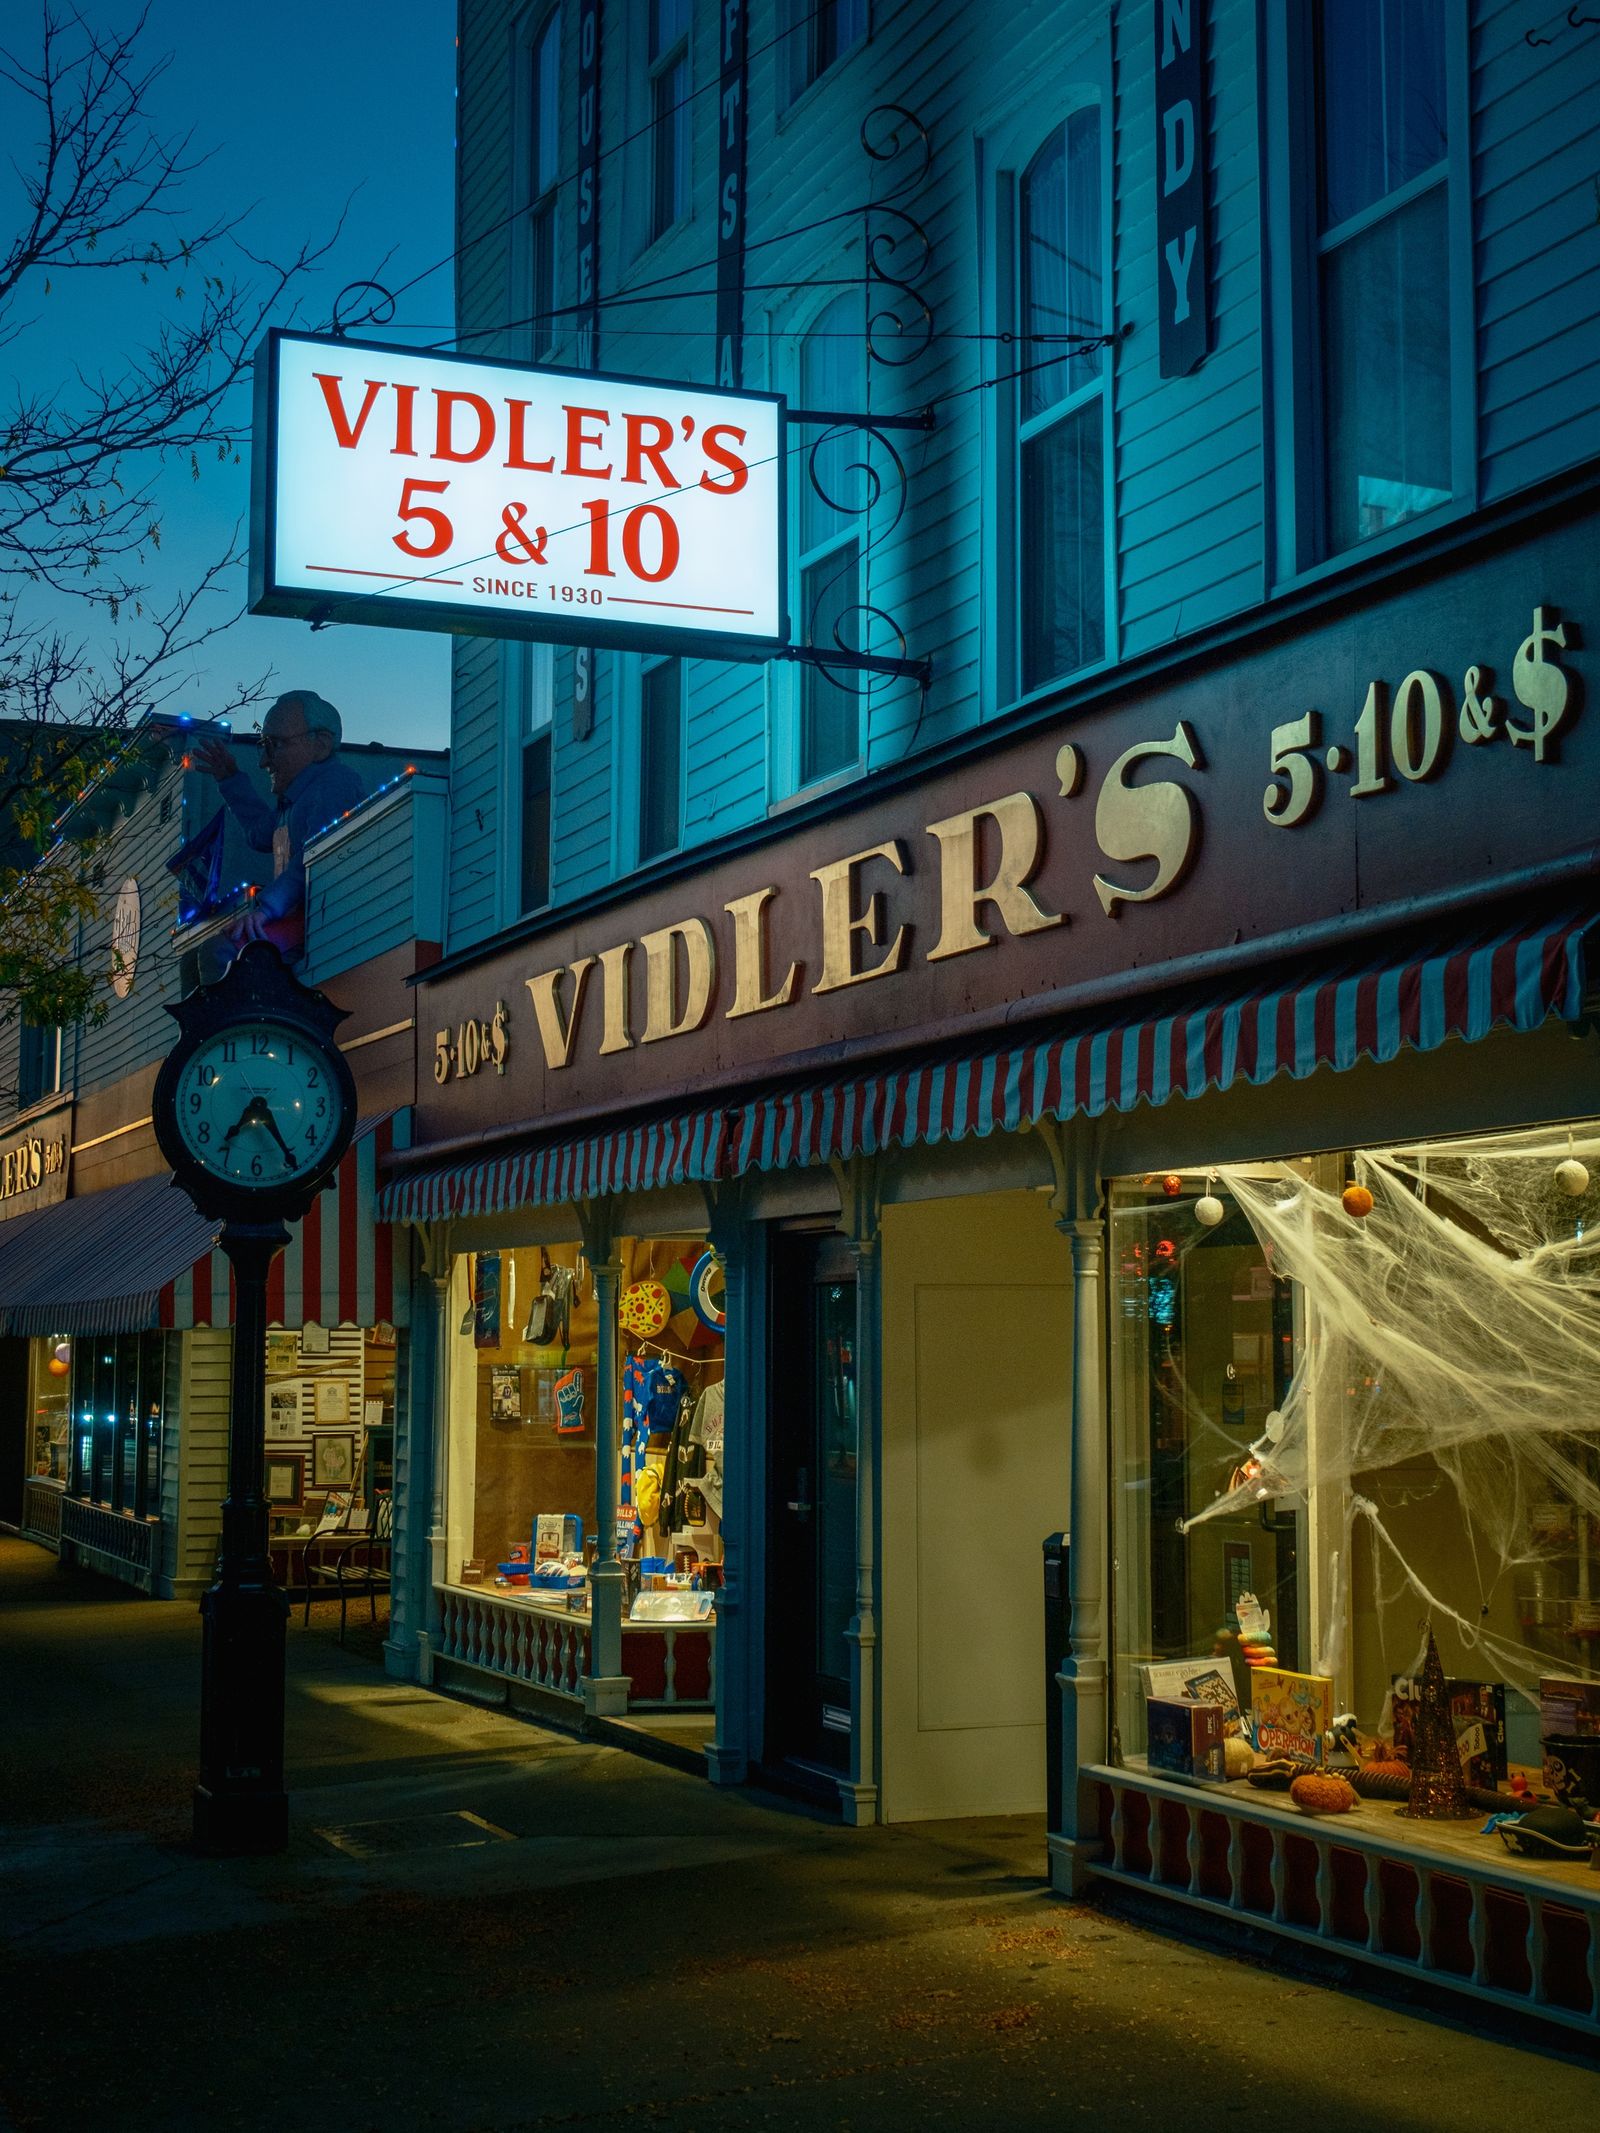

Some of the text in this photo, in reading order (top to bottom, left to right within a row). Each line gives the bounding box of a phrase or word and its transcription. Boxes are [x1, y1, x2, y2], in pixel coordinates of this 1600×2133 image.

[312, 372, 749, 495] VIDLER'S
[391, 477, 680, 583] 5 & 10
[472, 576, 603, 606] SINCE 1930
[525, 720, 1206, 1070] VIDLER'S
[222, 1041, 237, 1063] 11
[252, 1033, 270, 1056] 12
[287, 1043, 295, 1066] 1
[196, 1064, 216, 1087] 10
[306, 1066, 319, 1089] 2
[190, 1092, 201, 1115] 9
[315, 1096, 326, 1118] 3
[198, 1121, 210, 1144] 8
[304, 1123, 318, 1146] 4
[0, 1137, 42, 1200] ER'S
[218, 1146, 231, 1169] 7
[251, 1154, 263, 1177] 6
[1258, 1724, 1316, 1756] OPERATION
